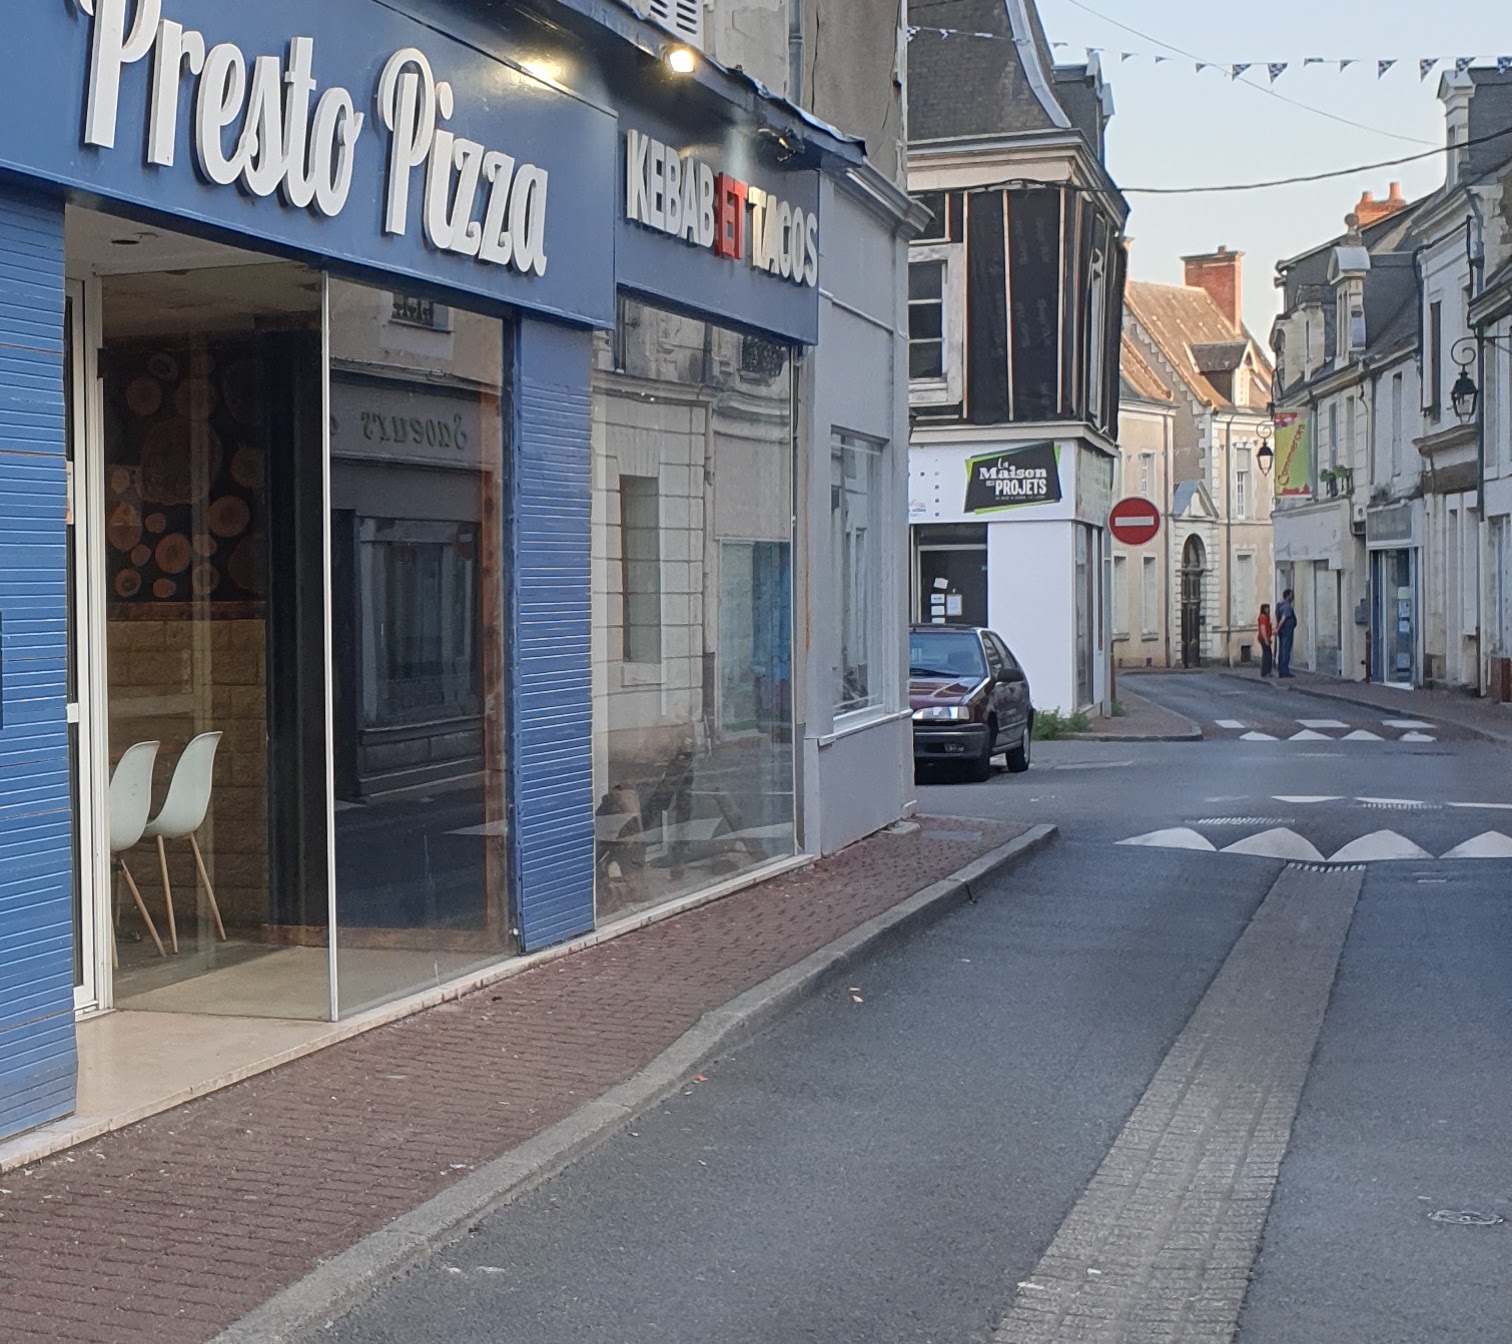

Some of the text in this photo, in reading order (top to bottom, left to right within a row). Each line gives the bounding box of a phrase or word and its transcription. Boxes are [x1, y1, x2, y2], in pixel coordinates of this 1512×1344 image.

[378, 47, 548, 277] Pizza
[627, 129, 818, 288] KEBAB ET TACOS
[979, 465, 1047, 480] Maison
[995, 479, 1047, 496] PROJETS
